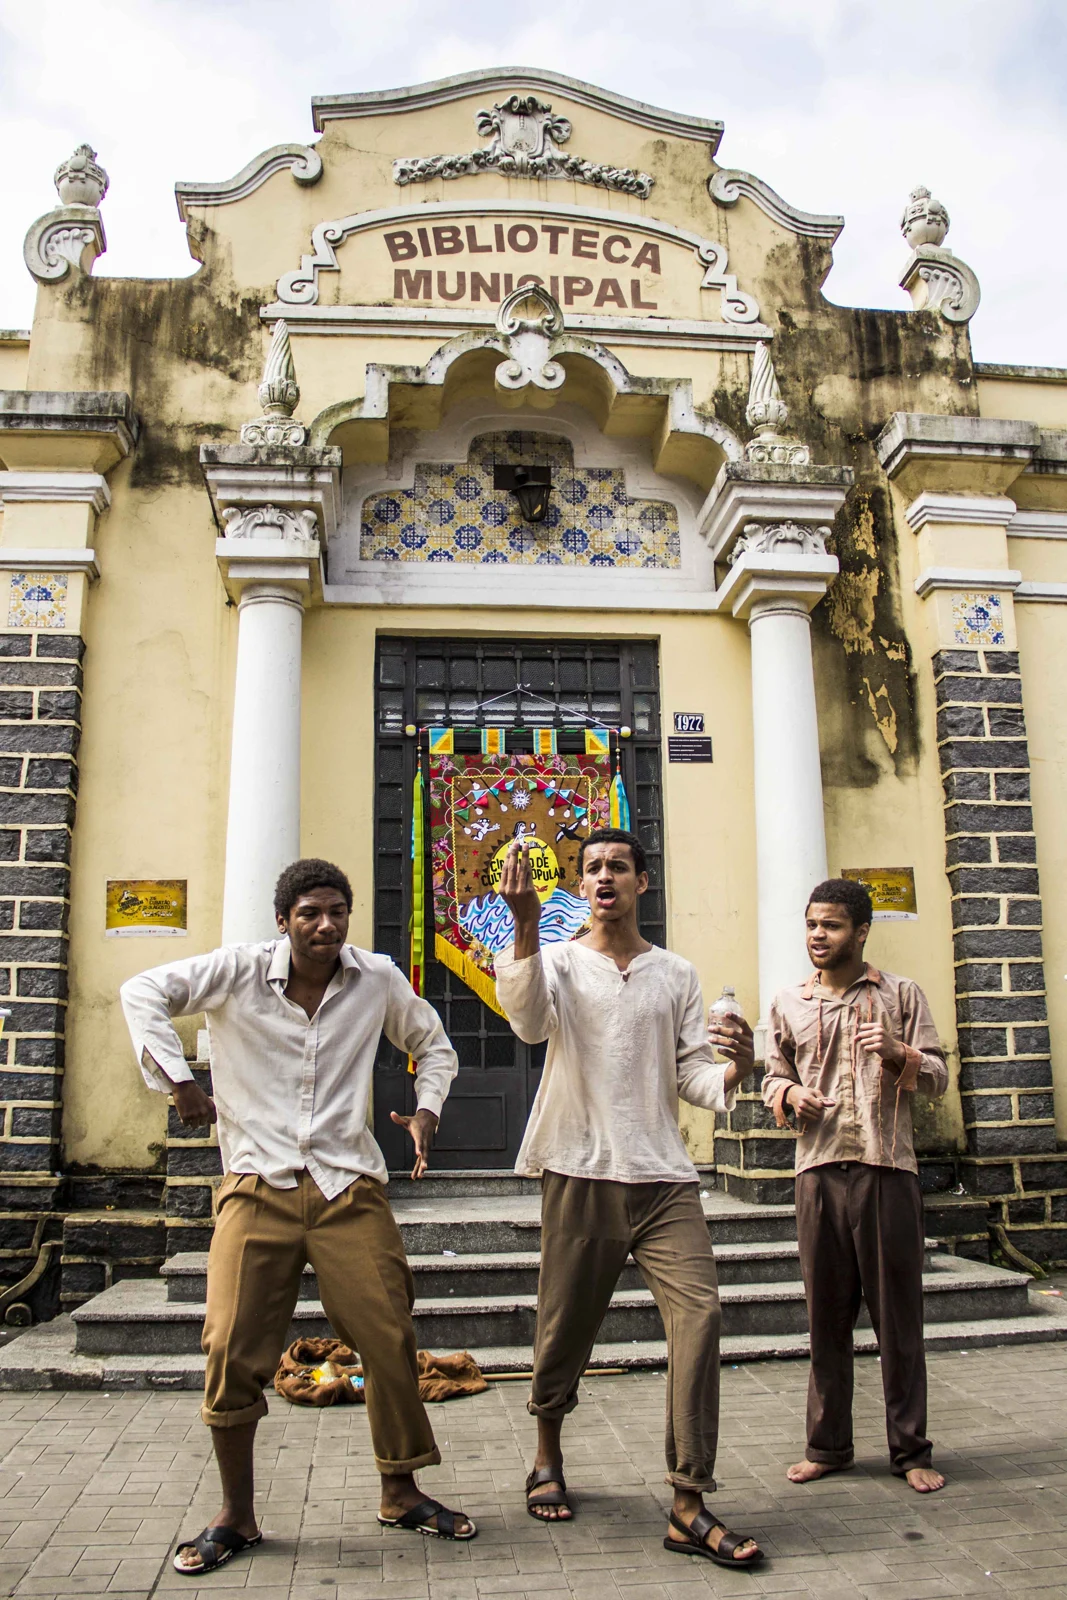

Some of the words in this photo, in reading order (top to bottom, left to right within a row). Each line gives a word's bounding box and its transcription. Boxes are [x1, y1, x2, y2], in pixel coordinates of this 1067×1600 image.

[384, 224, 661, 274] BIBLIOTECA
[677, 715, 702, 730] 1977
[536, 857, 549, 868] DE
[531, 867, 566, 881] OPULAR
